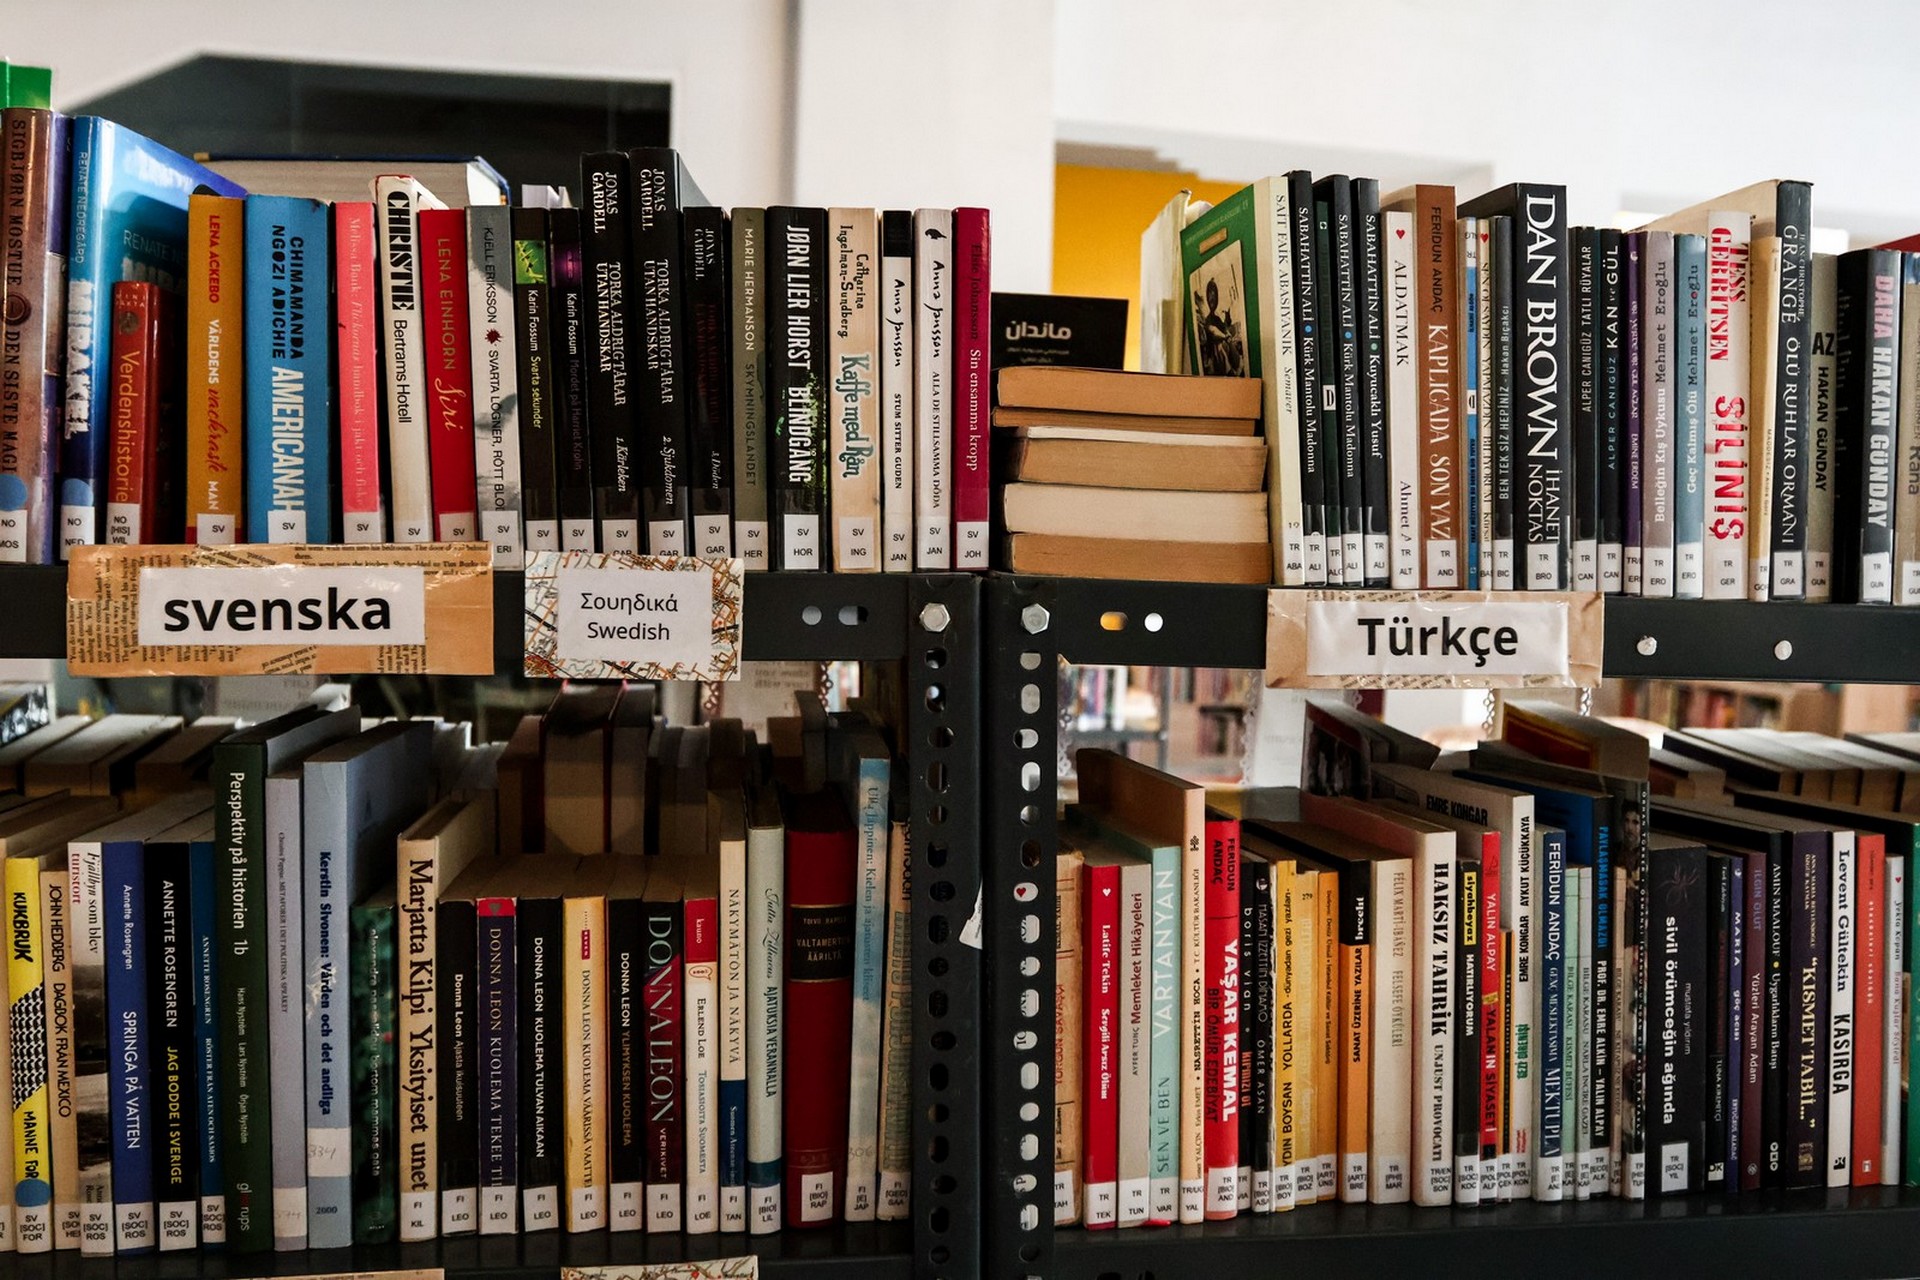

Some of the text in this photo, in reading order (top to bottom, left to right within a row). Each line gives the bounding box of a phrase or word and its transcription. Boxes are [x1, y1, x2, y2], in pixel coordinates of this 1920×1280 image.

[8, 119, 27, 287] SIGBJØRN MOSTUE
[75, 151, 90, 264] RENATE NEDREGÅRD
[208, 215, 220, 304] LENA ACKEBO
[592, 171, 618, 234] JONAS GARDELL
[1430, 206, 1446, 313] FERİDUN ANDAÇ
[272, 224, 286, 359] NGOZI ADICHIE
[290, 236, 304, 360] CHIMAMANDA
[387, 191, 415, 424] CHRISTIE Bertrams Hotell
[437, 238, 456, 370] LENA EINHORN
[528, 289, 540, 351] Karin Fossum
[596, 262, 613, 374] UTAN HANDSKAR
[787, 225, 811, 370] JØRN LIER HORST
[837, 225, 854, 338] Ingelman-Sundberg
[856, 253, 869, 310] Catharina
[885, 278, 905, 368] Anna Jansson
[1276, 195, 1293, 356] SAİT FAİK ABASIYANIK
[1394, 259, 1411, 367] ALDATMAK
[1526, 194, 1558, 459] DAN BROWN
[1605, 244, 1618, 349] KAN GÜL
[1656, 261, 1669, 384] Mehmet Eroğlu
[1709, 228, 1732, 361] GERRITSEN
[1729, 241, 1749, 303] TESS
[65, 281, 94, 440] MIRAKEL
[531, 356, 544, 429] Svarta sekunder
[610, 262, 627, 406] TORKA ALDRIG TÅRAR
[1365, 214, 1383, 459] SABAHATTİN ALİ Kuyucaklı Yusuf
[1780, 224, 1800, 545] GRANGÉ ÖLÜ RUHLAR ORMANI
[1812, 332, 1836, 357] AZ
[1, 331, 20, 474] DEN SISTE MAGI
[115, 350, 141, 503] Verdenshistorie
[207, 320, 228, 511] VÄRLDENS vackraste MAN
[272, 366, 304, 512] AMERICANAH
[434, 377, 463, 432] Siri
[787, 385, 816, 483] BLINDGÅNG
[836, 354, 874, 479] Kaffe med Rån
[893, 393, 903, 490] STUM SITTER GUDEN
[967, 348, 982, 471] Sin ensamma kropp
[1427, 323, 1453, 540] KAPLICADA SON YAZ
[1653, 388, 1669, 523] Belleğin Kış Uykusu
[1815, 366, 1830, 492] HAKAN GÜNDAY
[1867, 275, 1895, 528] DAHA HAKAN GÜNDAY
[1545, 467, 1562, 542] İHANET
[1713, 394, 1747, 541] SİLİNİŞ
[793, 548, 813, 556] HOR
[797, 528, 809, 536] SV
[162, 586, 393, 633] svenska
[579, 591, 679, 617] Σουηδικά
[586, 619, 671, 642] Swedish
[1357, 616, 1519, 668] Türkçe
[229, 771, 249, 956] Perspektiv på historien 1b
[1211, 839, 1223, 885] ANDAÇ
[1225, 838, 1237, 892] FERİDUN
[1465, 875, 1476, 942] siyahbeyaz
[1545, 842, 1562, 961] FERİDUN ANDAÇ
[12, 891, 34, 963] KUKBRUK
[49, 884, 66, 972] JOHN HEDBERG
[318, 851, 335, 1115] Kerstin Sivonen: Vården och det andliga
[402, 860, 434, 1015] Marjatta Kilpi
[726, 889, 741, 1063] NÄKYMÄTÖN JA NÄKYVÄ
[1130, 892, 1145, 1024] Memleket Hikâyeleri
[1153, 870, 1175, 1039] VARTANYAN
[1432, 863, 1452, 1036] HAKSIZ TAHRİK
[1832, 850, 1850, 1094] Levent Gültekin KASIRGA
[53, 983, 72, 1118] DAGBOK FRÅN MEXICO
[647, 915, 674, 1122] DONNA LEON
[1221, 939, 1239, 1121] YAŞAR KEMAL
[1464, 954, 1475, 1036] HATIRLIYORUM
[1662, 916, 1678, 1125] sivil örümceğin ağında
[1802, 956, 1819, 1050] “KISMET
[122, 1011, 143, 1149] SPRINGA PÅ VATTEN
[167, 1045, 180, 1072] JAG
[168, 1074, 181, 1119] BODDE
[402, 1024, 432, 1190] Yksityiset unet
[169, 1130, 182, 1185] SVERIGE
